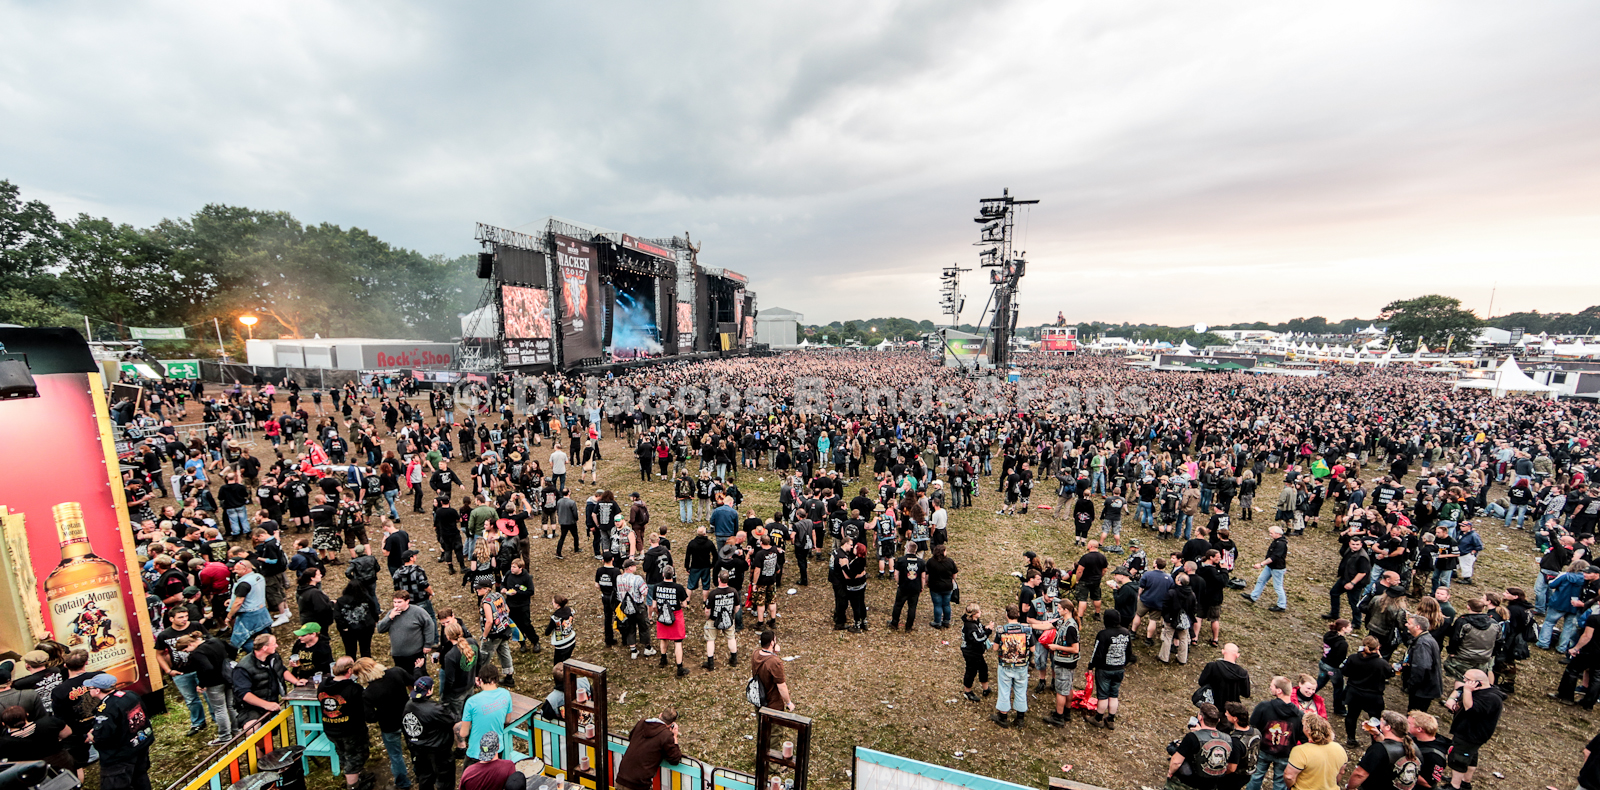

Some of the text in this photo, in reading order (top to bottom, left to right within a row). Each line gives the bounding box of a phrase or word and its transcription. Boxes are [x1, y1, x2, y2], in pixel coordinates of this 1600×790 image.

[557, 251, 590, 271] WACKEN
[565, 268, 583, 276] 2012
[377, 351, 410, 367] Rock
[422, 351, 451, 366] Shop
[61, 522, 81, 531] Captain
[62, 529, 83, 538] Morgan
[657, 586, 677, 594] FASTER
[54, 590, 118, 616] Captain Morgan
[104, 648, 127, 660] GOLD
